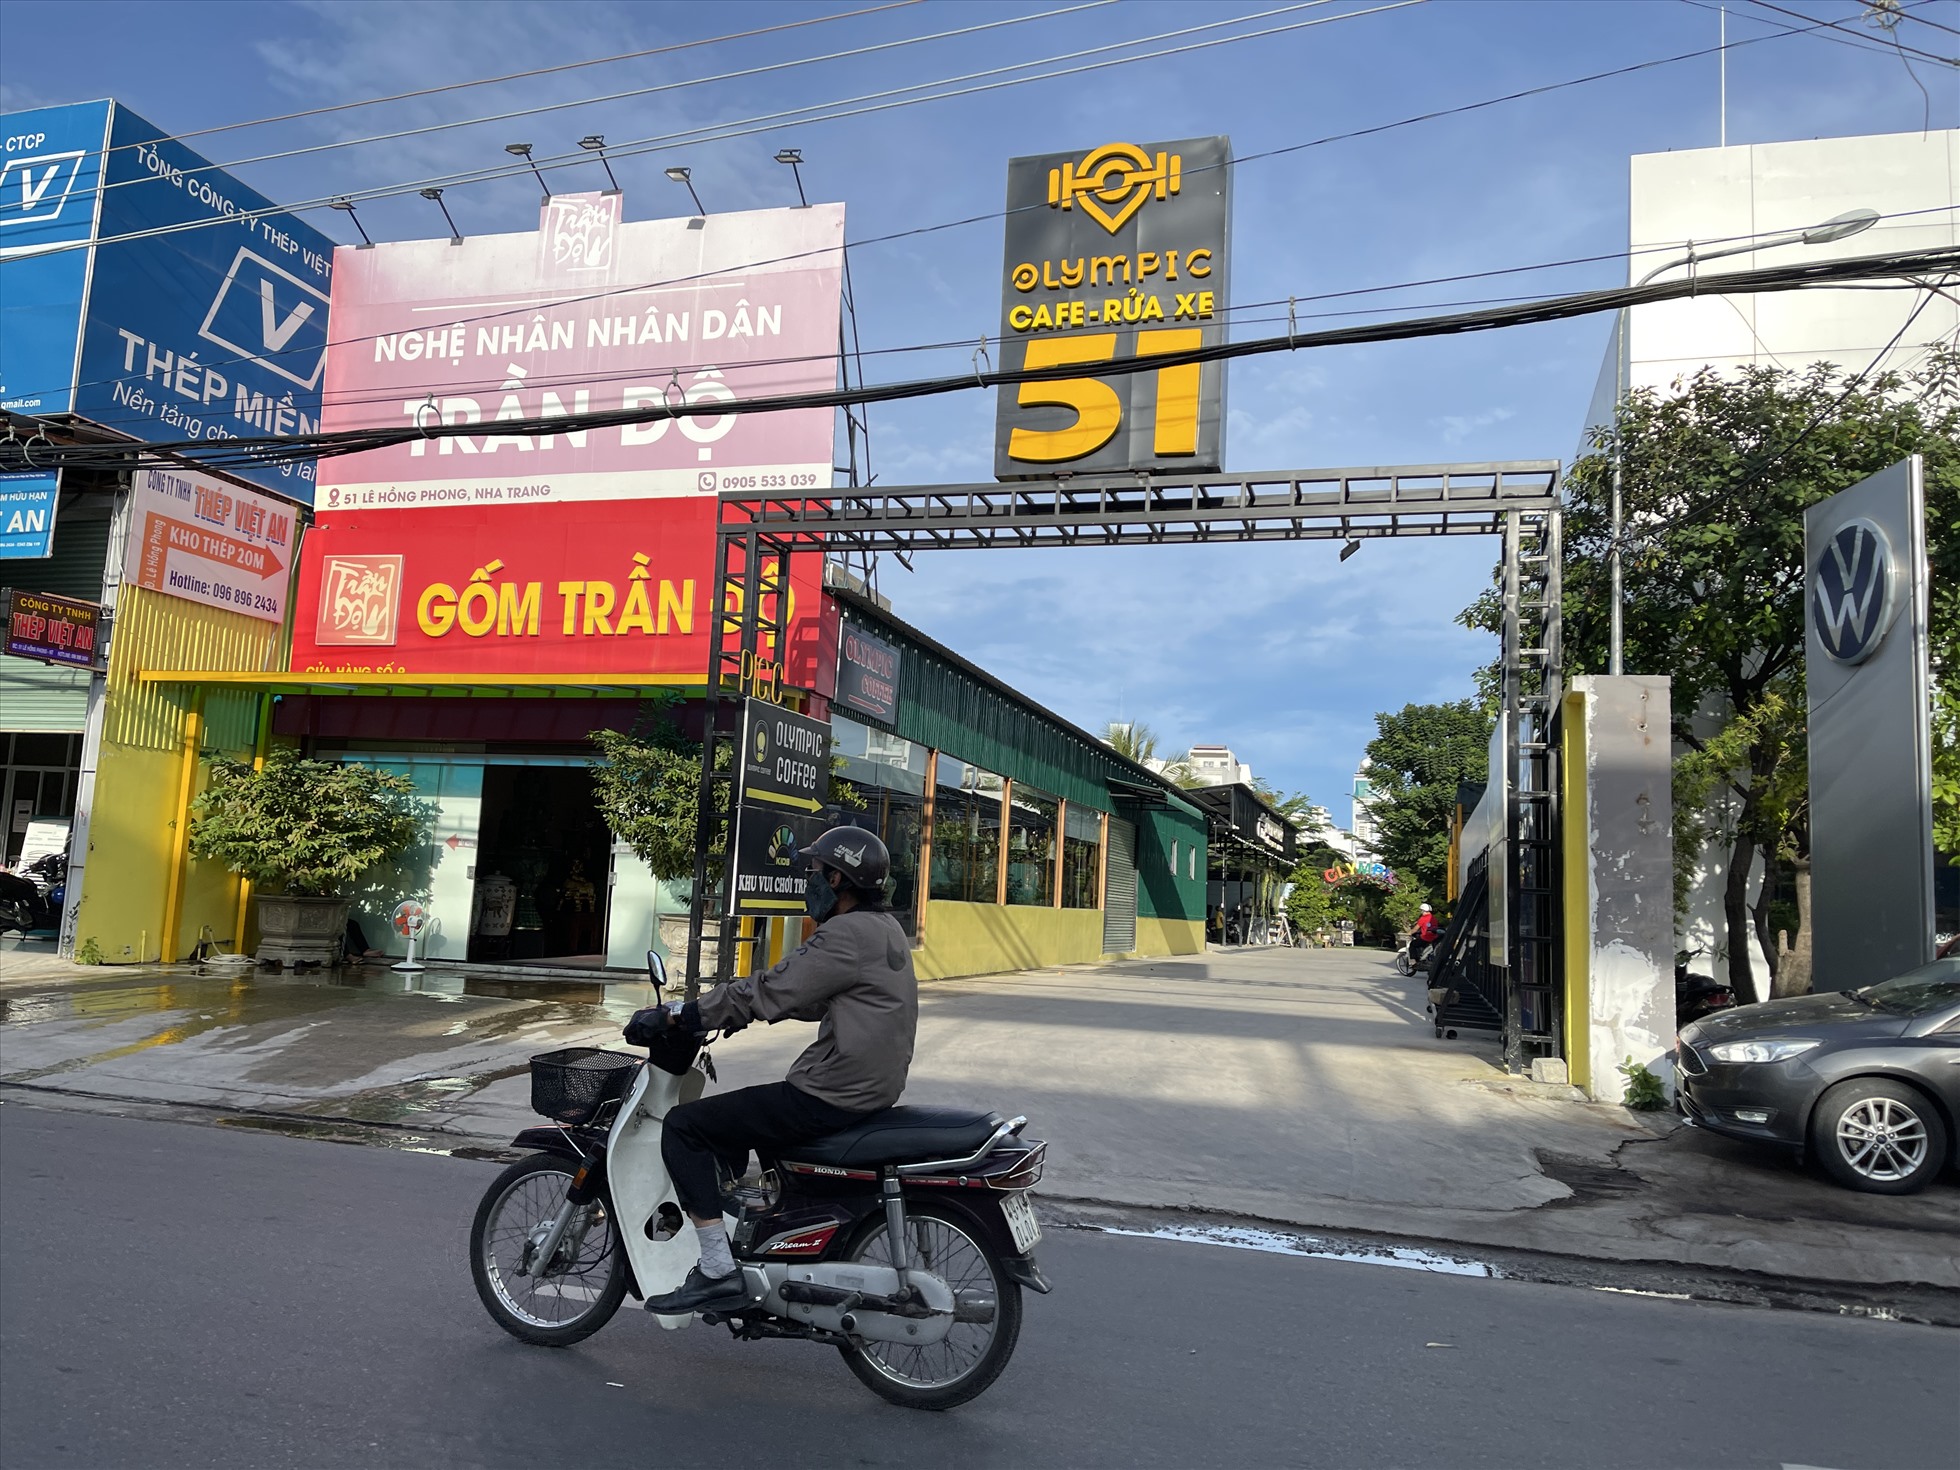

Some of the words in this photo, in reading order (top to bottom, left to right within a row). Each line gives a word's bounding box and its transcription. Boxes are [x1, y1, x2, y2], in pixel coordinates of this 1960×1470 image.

[6, 133, 45, 152] CTCP
[137, 143, 184, 188] TỔNG
[188, 182, 235, 218] CÔNG
[239, 208, 258, 232] TY
[262, 222, 298, 255] THÉP
[303, 246, 332, 278] VIỆT
[1011, 248, 1213, 292] OLYMPIC
[1174, 290, 1215, 320] XE
[374, 322, 466, 366] NGHỆ
[476, 314, 575, 356] NHÂN
[587, 305, 689, 348] NHÂN
[702, 298, 782, 341] DÂN
[118, 328, 229, 406] THÉP
[112, 381, 155, 416] Nền
[160, 402, 203, 439] tảng
[404, 362, 590, 456] TRẦN
[1007, 328, 1203, 463] 51
[29, 491, 48, 502] HẠN
[166, 475, 175, 496] TY
[175, 478, 192, 502] TNHH
[343, 493, 358, 505] 51
[362, 489, 375, 504] LÊ
[378, 485, 417, 503] HỒNG
[420, 488, 471, 502] PHONG,
[475, 487, 503, 499] NHA
[507, 484, 551, 498] TRANG
[722, 475, 757, 489] 0905
[760, 474, 787, 487] 533
[790, 473, 817, 487] 039
[6, 508, 46, 533] AN
[150, 518, 167, 545] Phong
[194, 485, 232, 527] THÉP
[235, 499, 267, 542] VIỆT
[266, 512, 289, 547] AN
[170, 526, 200, 550] KHO
[203, 537, 236, 560] THÉP
[237, 548, 265, 570] 20M
[20, 597, 49, 612] CÔNG
[51, 603, 63, 615] TY
[66, 607, 92, 620] TNHH
[169, 570, 210, 596] Hotline:
[213, 583, 232, 601] 096
[234, 588, 253, 607] 896
[254, 595, 278, 614] 2434
[416, 558, 544, 638] GỐM
[558, 551, 697, 636] TRẦN
[13, 611, 46, 640] THÉP
[48, 616, 75, 650] VIỆT
[75, 625, 94, 650] AN
[846, 634, 894, 680] OLYMPIC
[775, 720, 823, 758] OLYMPIC
[738, 874, 758, 892] KHU
[758, 875, 774, 893] VUI
[774, 874, 794, 894] CHƠI
[814, 1166, 848, 1177] HONDA
[769, 1241, 812, 1250] Dream
